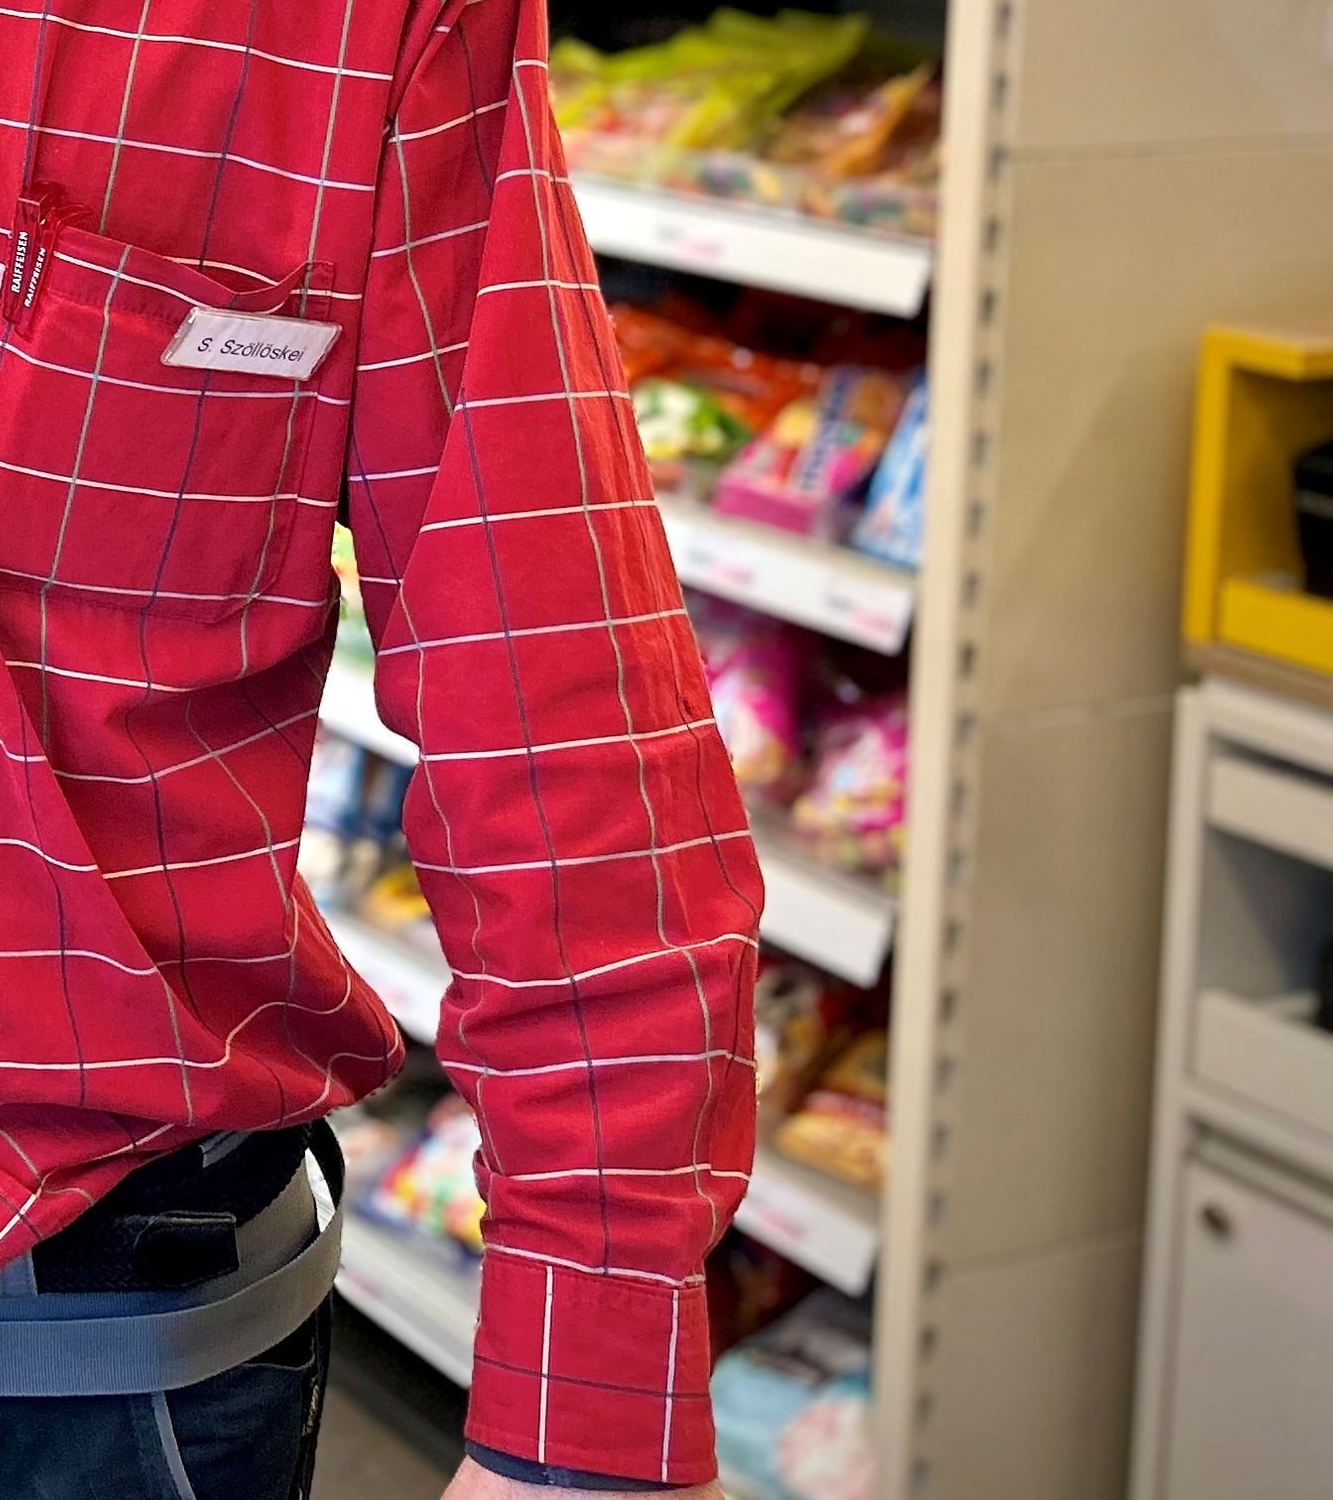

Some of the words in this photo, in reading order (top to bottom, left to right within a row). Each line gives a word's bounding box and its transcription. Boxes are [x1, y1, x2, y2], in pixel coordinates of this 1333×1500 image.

[11, 231, 28, 293] RAIFFEISEN
[24, 247, 46, 307] RAIFFEISEN
[197, 337, 213, 353] S.
